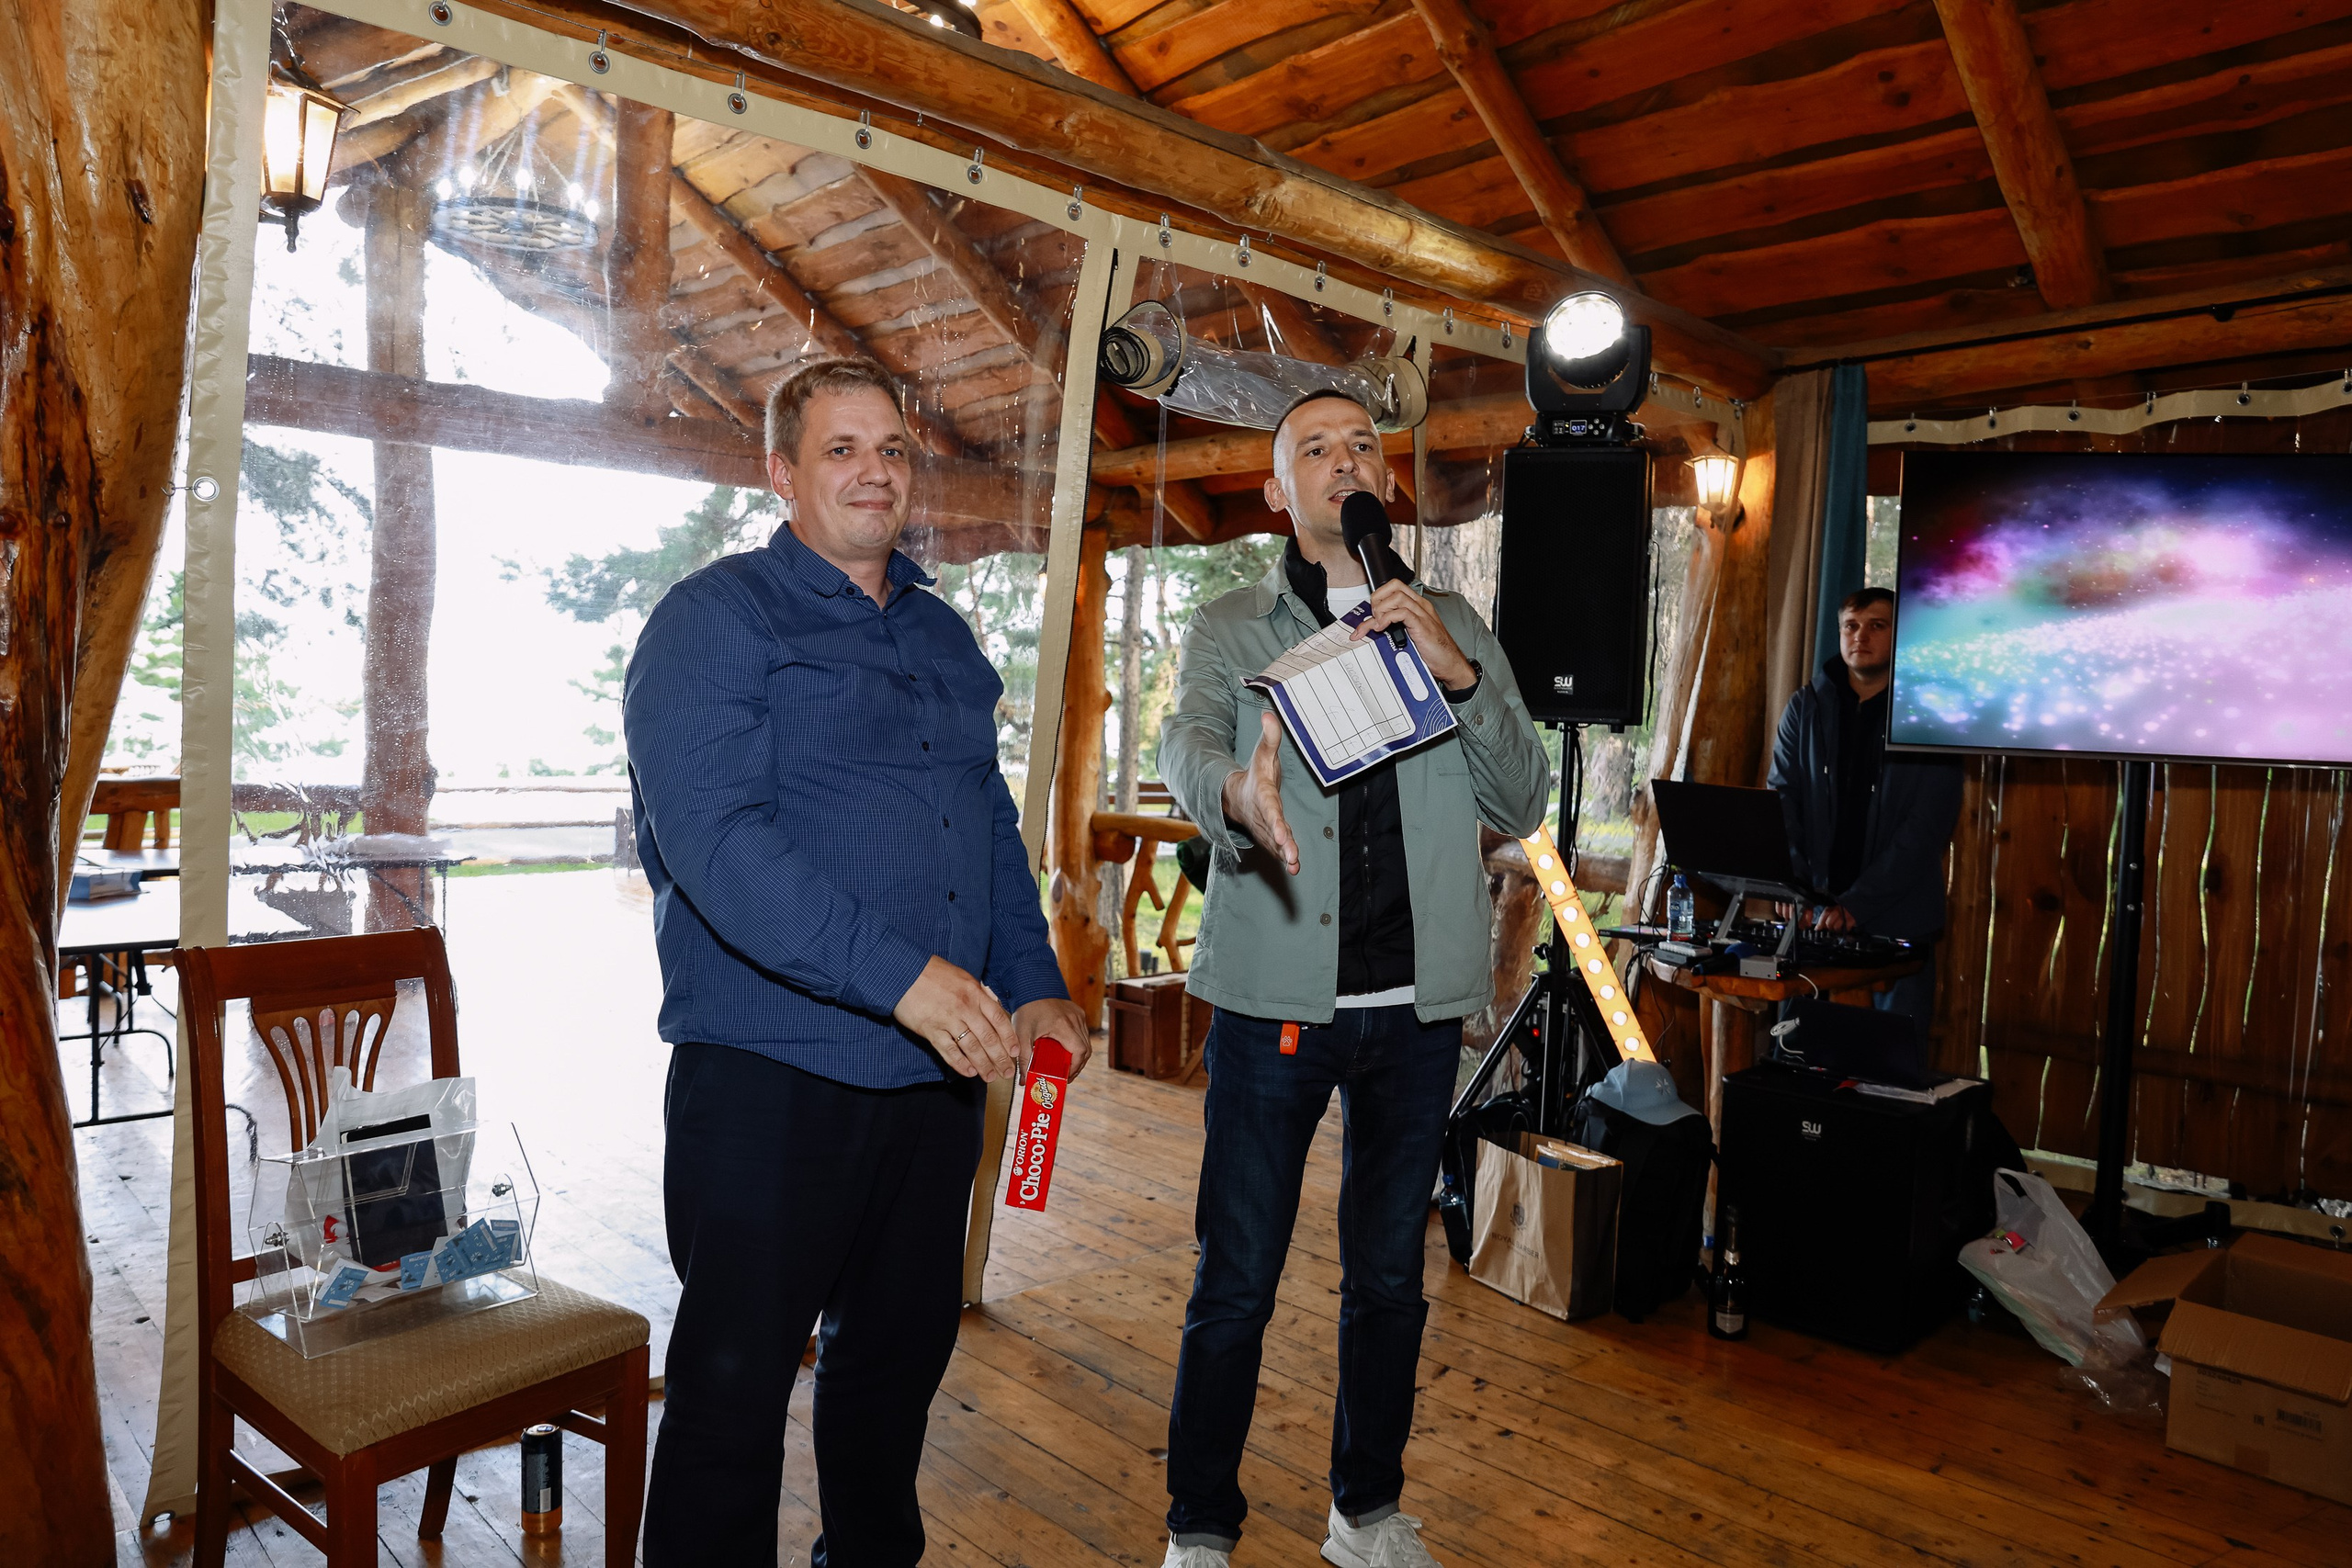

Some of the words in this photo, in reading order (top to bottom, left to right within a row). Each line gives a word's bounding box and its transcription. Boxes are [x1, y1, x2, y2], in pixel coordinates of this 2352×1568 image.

[1554, 676, 1573, 687] SW
[1036, 1077, 1055, 1110] Original
[1015, 1130, 1029, 1166] ORION
